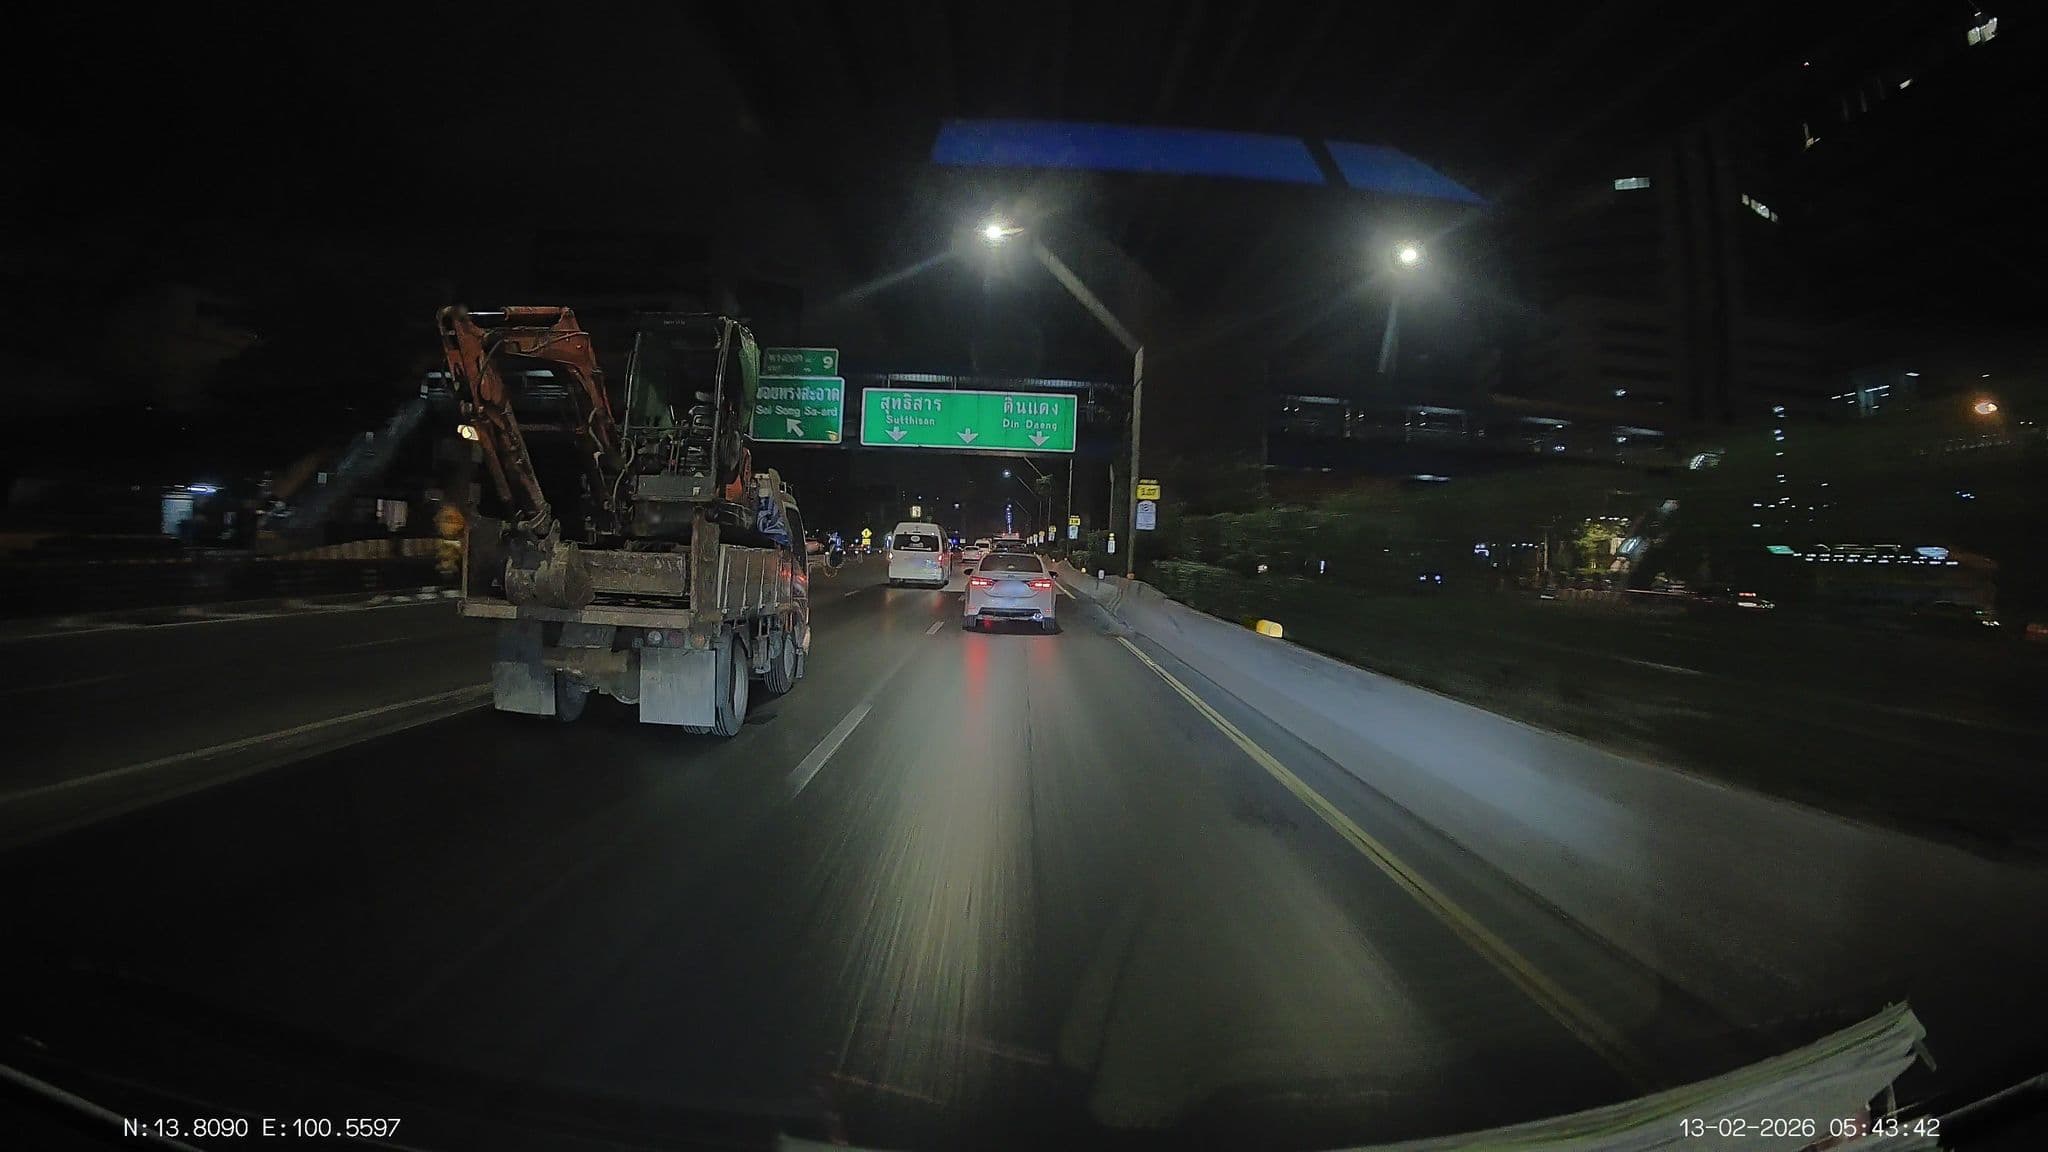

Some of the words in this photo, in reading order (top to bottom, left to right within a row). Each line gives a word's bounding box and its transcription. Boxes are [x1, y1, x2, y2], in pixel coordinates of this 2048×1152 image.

[823, 356, 833, 369] 9
[880, 393, 943, 414] สุทธิสาร
[1003, 396, 1059, 415] ดินแดง
[1003, 418, 1020, 428] Din
[1026, 419, 1057, 432] Daeng
